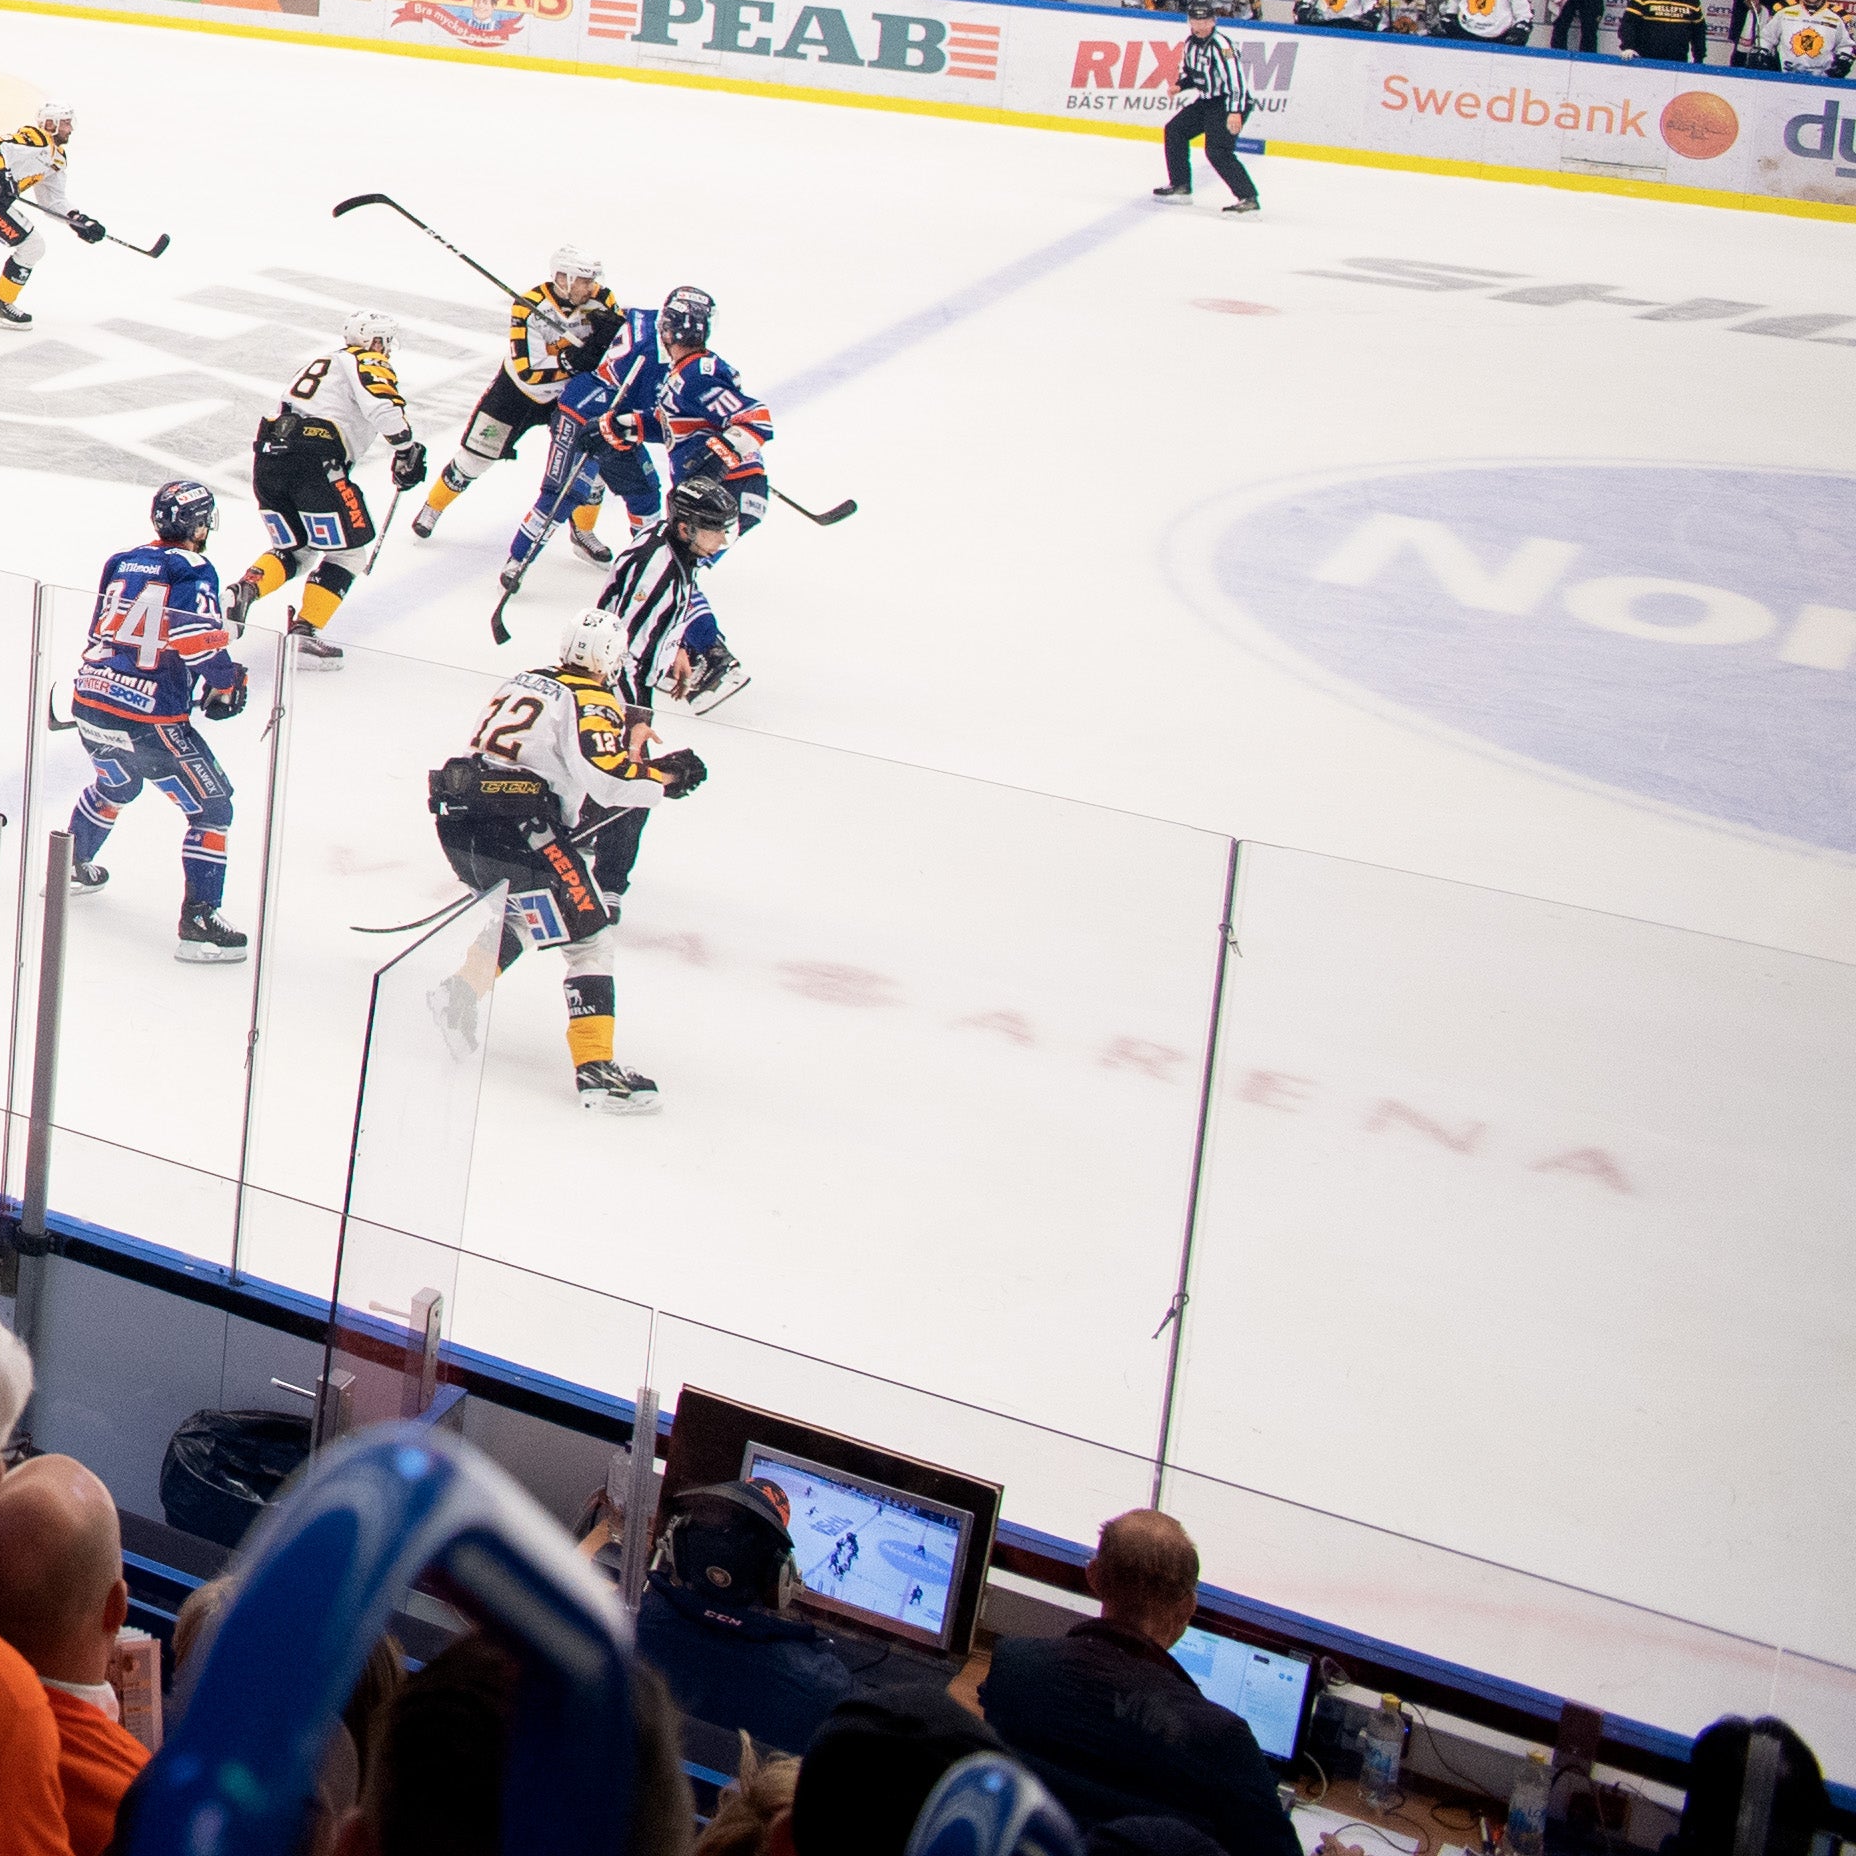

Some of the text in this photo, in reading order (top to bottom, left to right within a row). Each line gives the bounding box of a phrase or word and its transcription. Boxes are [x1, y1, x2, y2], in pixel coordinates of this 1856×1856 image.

[1070, 40, 1186, 90] RIX
[1066, 89, 1119, 111] BÄST
[1122, 94, 1186, 113] MUSIK
[1380, 74, 1647, 139] Swedbank
[706, 388, 744, 418] 70
[470, 694, 546, 763] 12
[590, 732, 617, 755] 12
[542, 842, 597, 914] REPAY
[703, 1609, 744, 1627] CCM
